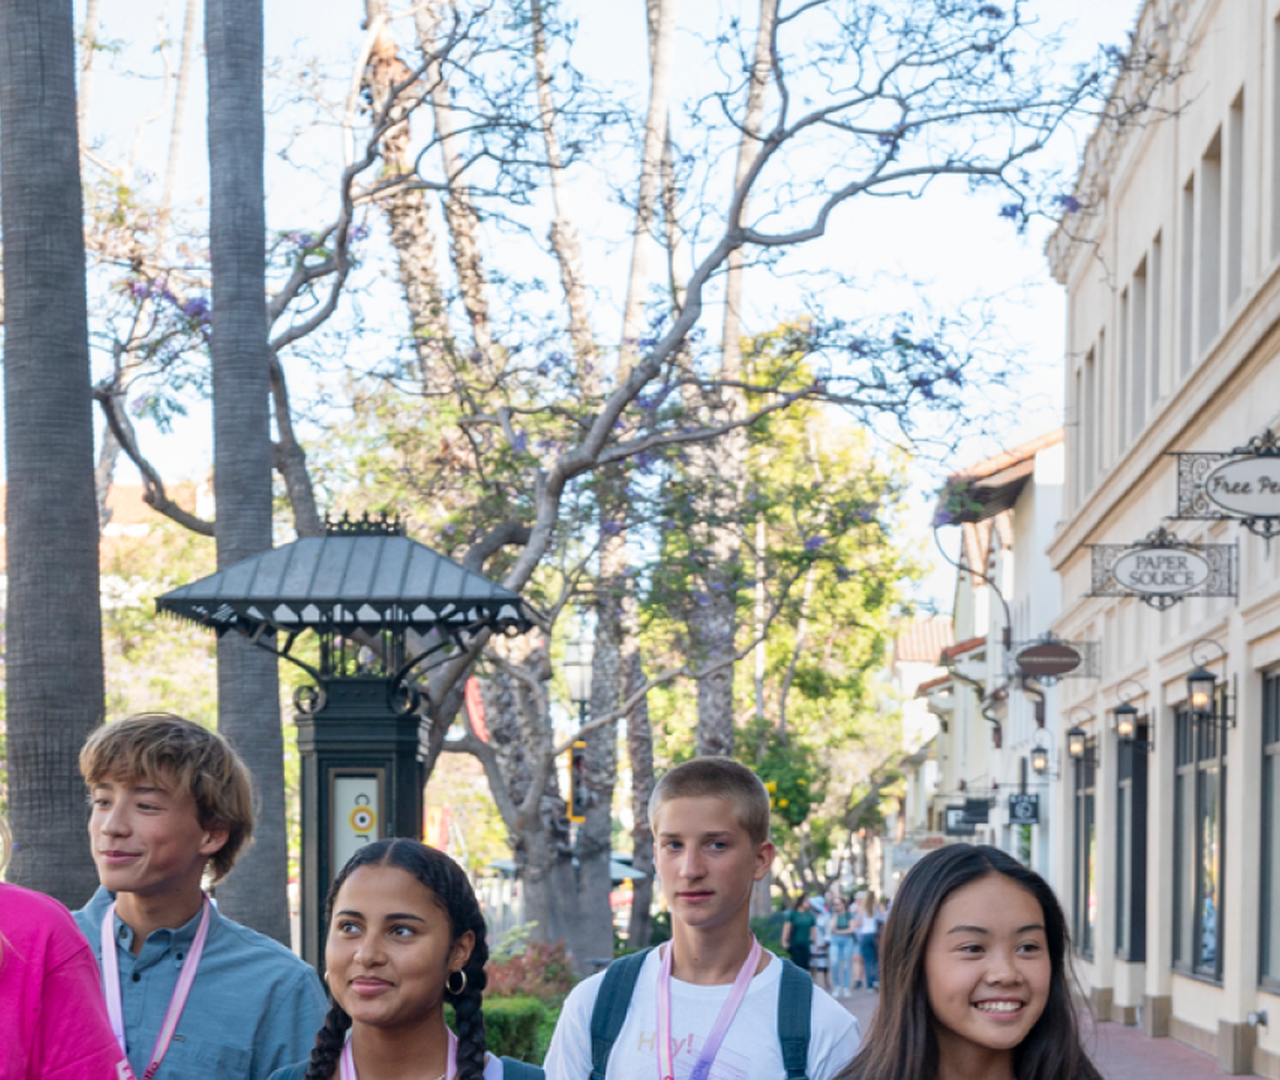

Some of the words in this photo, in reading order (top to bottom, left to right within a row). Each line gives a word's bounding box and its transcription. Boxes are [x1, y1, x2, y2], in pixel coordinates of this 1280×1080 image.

[1211, 474, 1253, 495] Free
[1135, 555, 1189, 571] PAPER
[1128, 570, 1195, 587] SOURCE
[636, 1030, 695, 1058] Hy!
